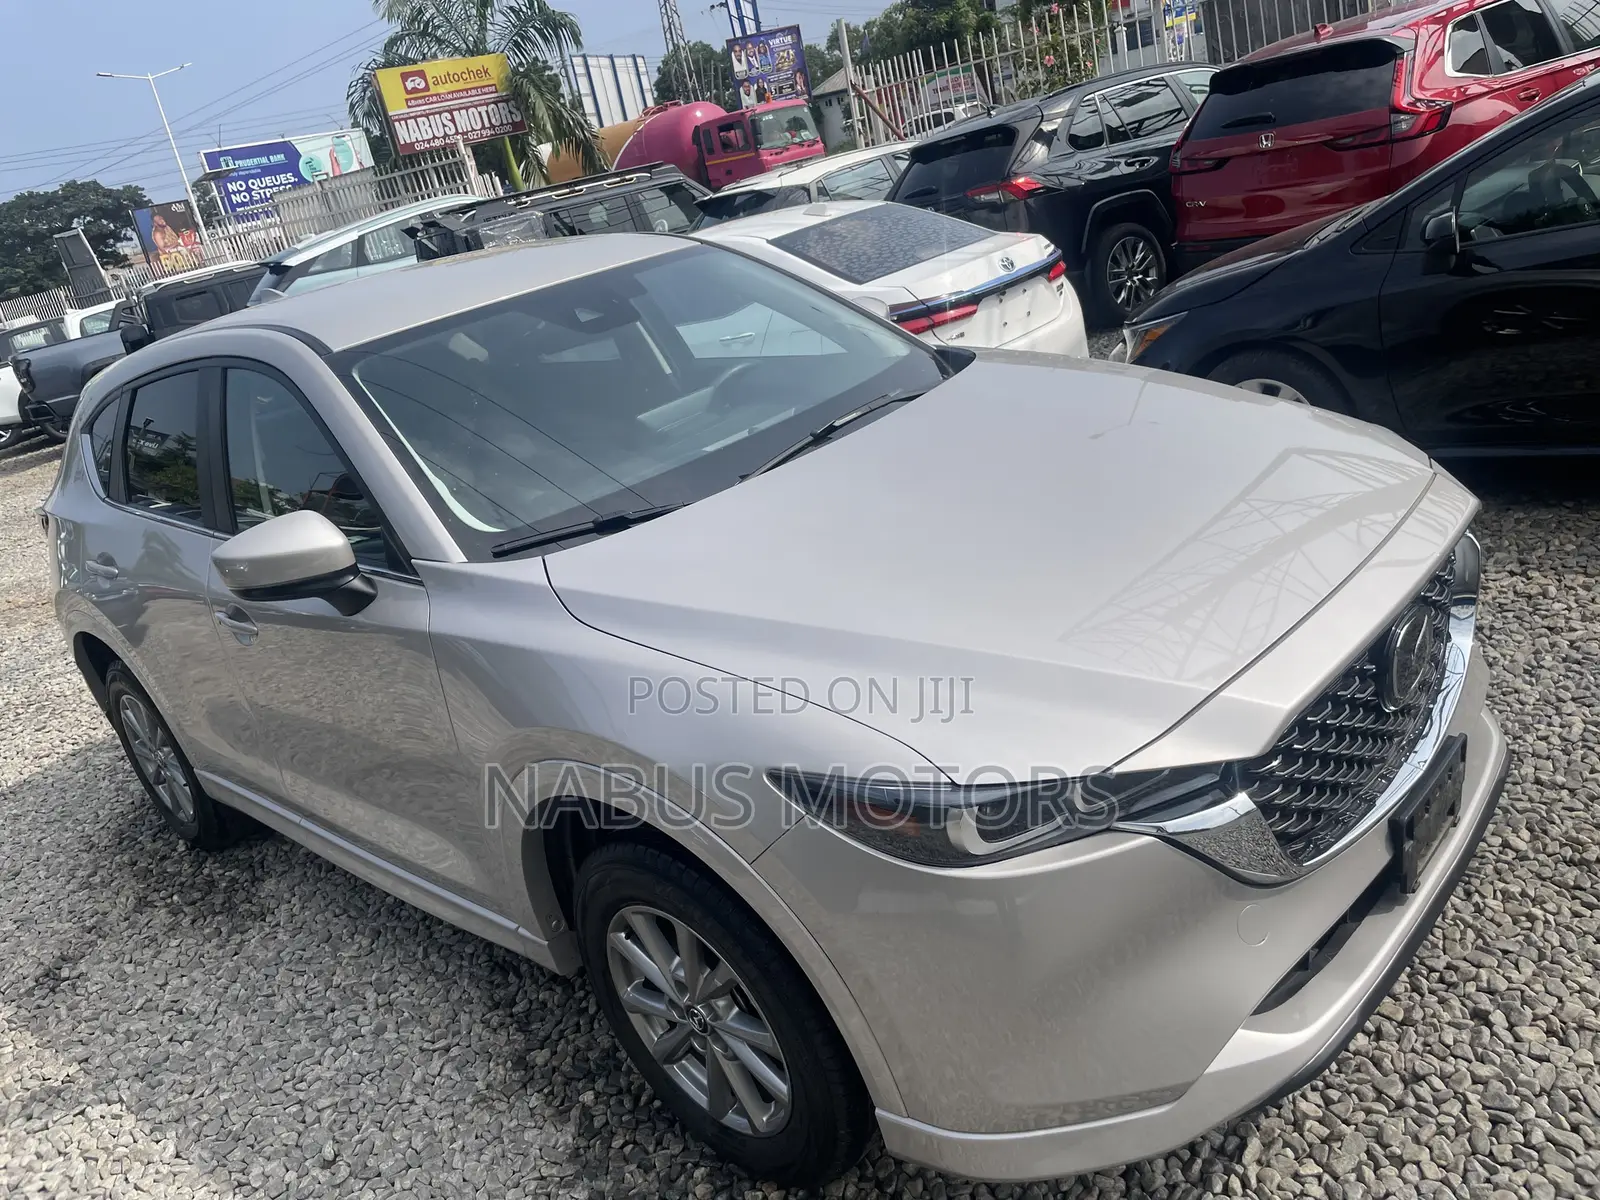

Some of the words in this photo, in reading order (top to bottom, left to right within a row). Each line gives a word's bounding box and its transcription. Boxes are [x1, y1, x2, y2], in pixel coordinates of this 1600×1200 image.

[768, 35, 793, 46] VIRTUE
[431, 65, 492, 87] autochek
[424, 96, 438, 104] CAR
[436, 94, 454, 103] LOAN
[452, 89, 483, 101] AVAILABLE
[481, 85, 497, 94] HERE
[394, 112, 456, 145] NABUS
[452, 100, 522, 133] MOTORS
[414, 140, 431, 151] 024
[429, 137, 446, 149] 480
[468, 130, 482, 140] 027
[480, 126, 496, 138] 994
[495, 124, 513, 135] 0200
[235, 156, 270, 168] PRUDENTIAL
[269, 153, 286, 163] BANK
[227, 180, 247, 193] NO
[248, 173, 299, 191] QUEUES.
[231, 191, 250, 204] NO
